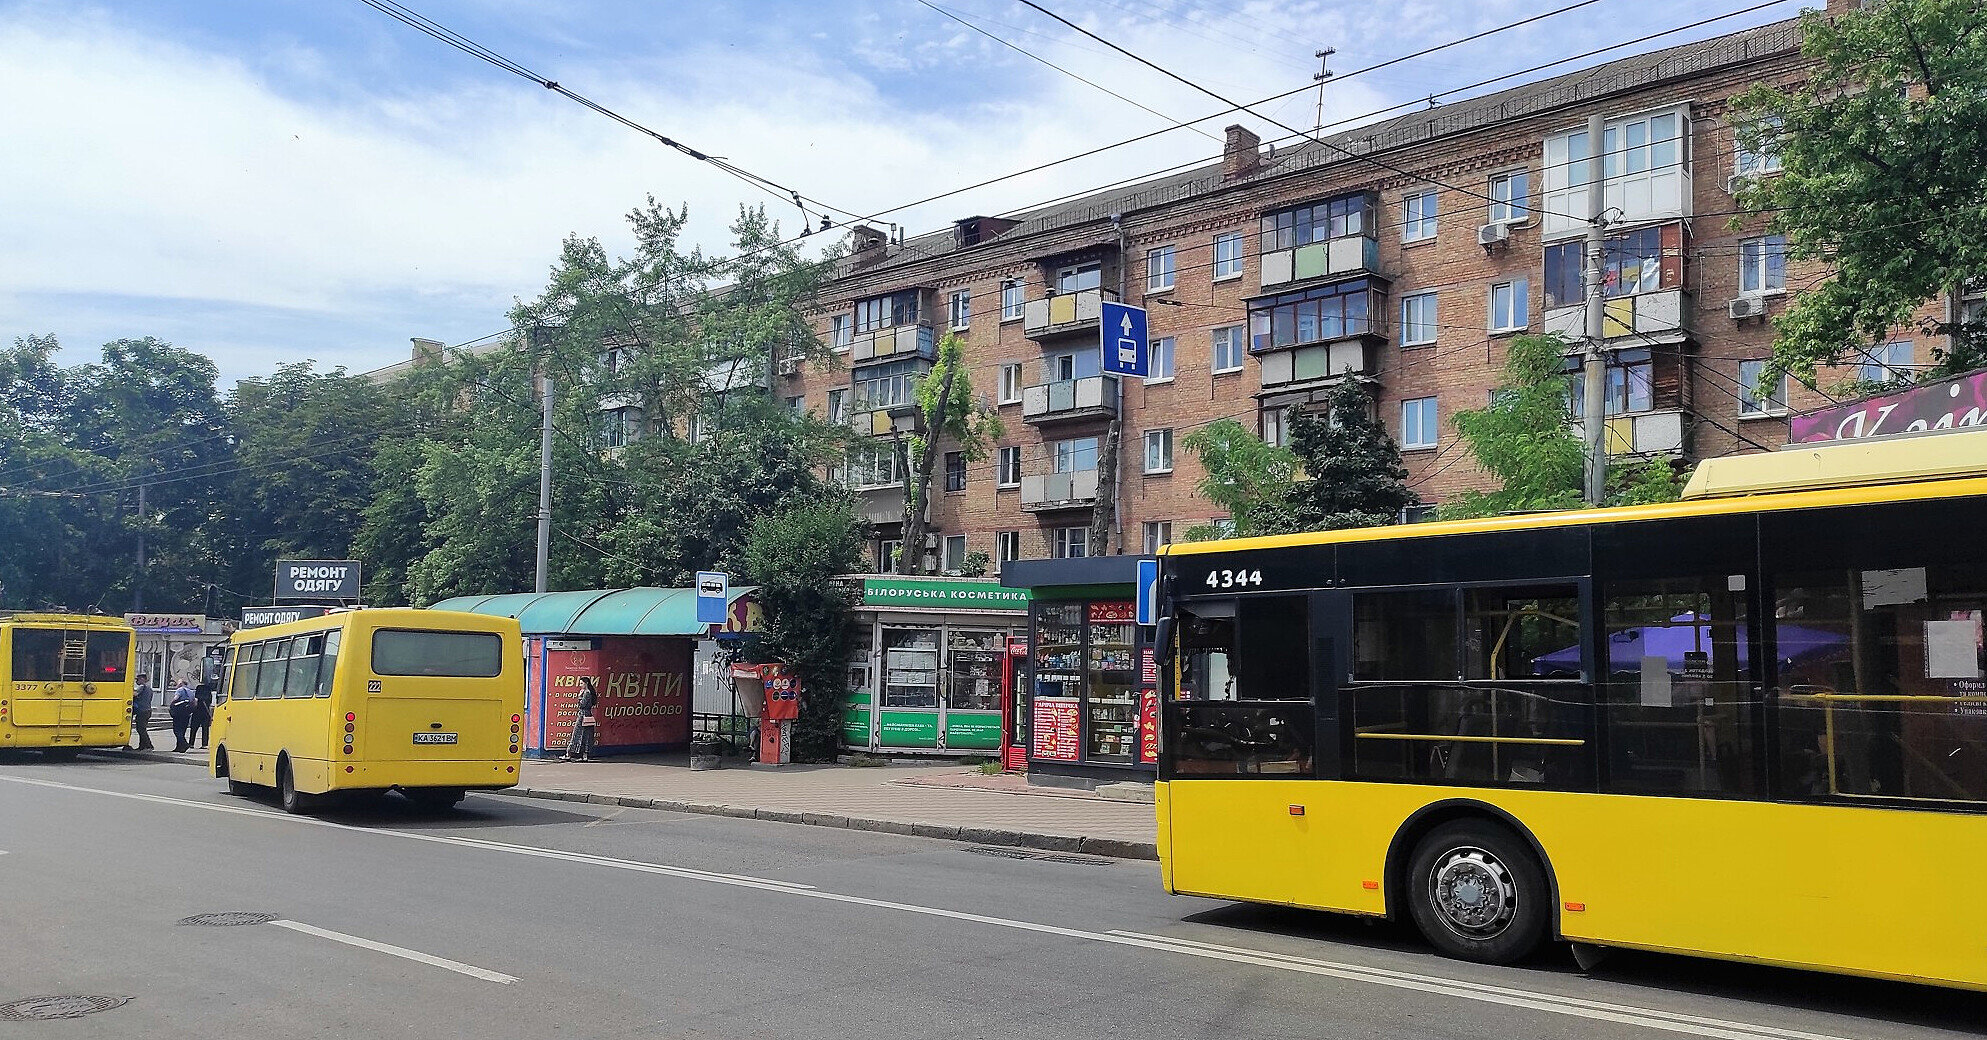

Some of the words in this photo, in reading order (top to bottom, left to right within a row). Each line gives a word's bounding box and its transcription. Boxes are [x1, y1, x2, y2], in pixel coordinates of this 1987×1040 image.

[290, 566, 348, 579] РЕМОНТ
[1206, 569, 1263, 588] 4344
[293, 579, 343, 592] ОДЯГУ
[867, 588, 947, 599] БІЛОРУСЬКА
[950, 590, 1027, 601] КОСМЕТИКА
[244, 612, 276, 625] РЕМОНТ
[275, 611, 301, 624] ОДЯГУ
[15, 683, 38, 691] 3377
[368, 681, 381, 692] 222
[554, 675, 601, 687] КВІИ
[605, 672, 683, 698] КВІТИ
[604, 702, 683, 719] цілодобово
[418, 734, 429, 742] KA
[430, 734, 445, 742] 3621
